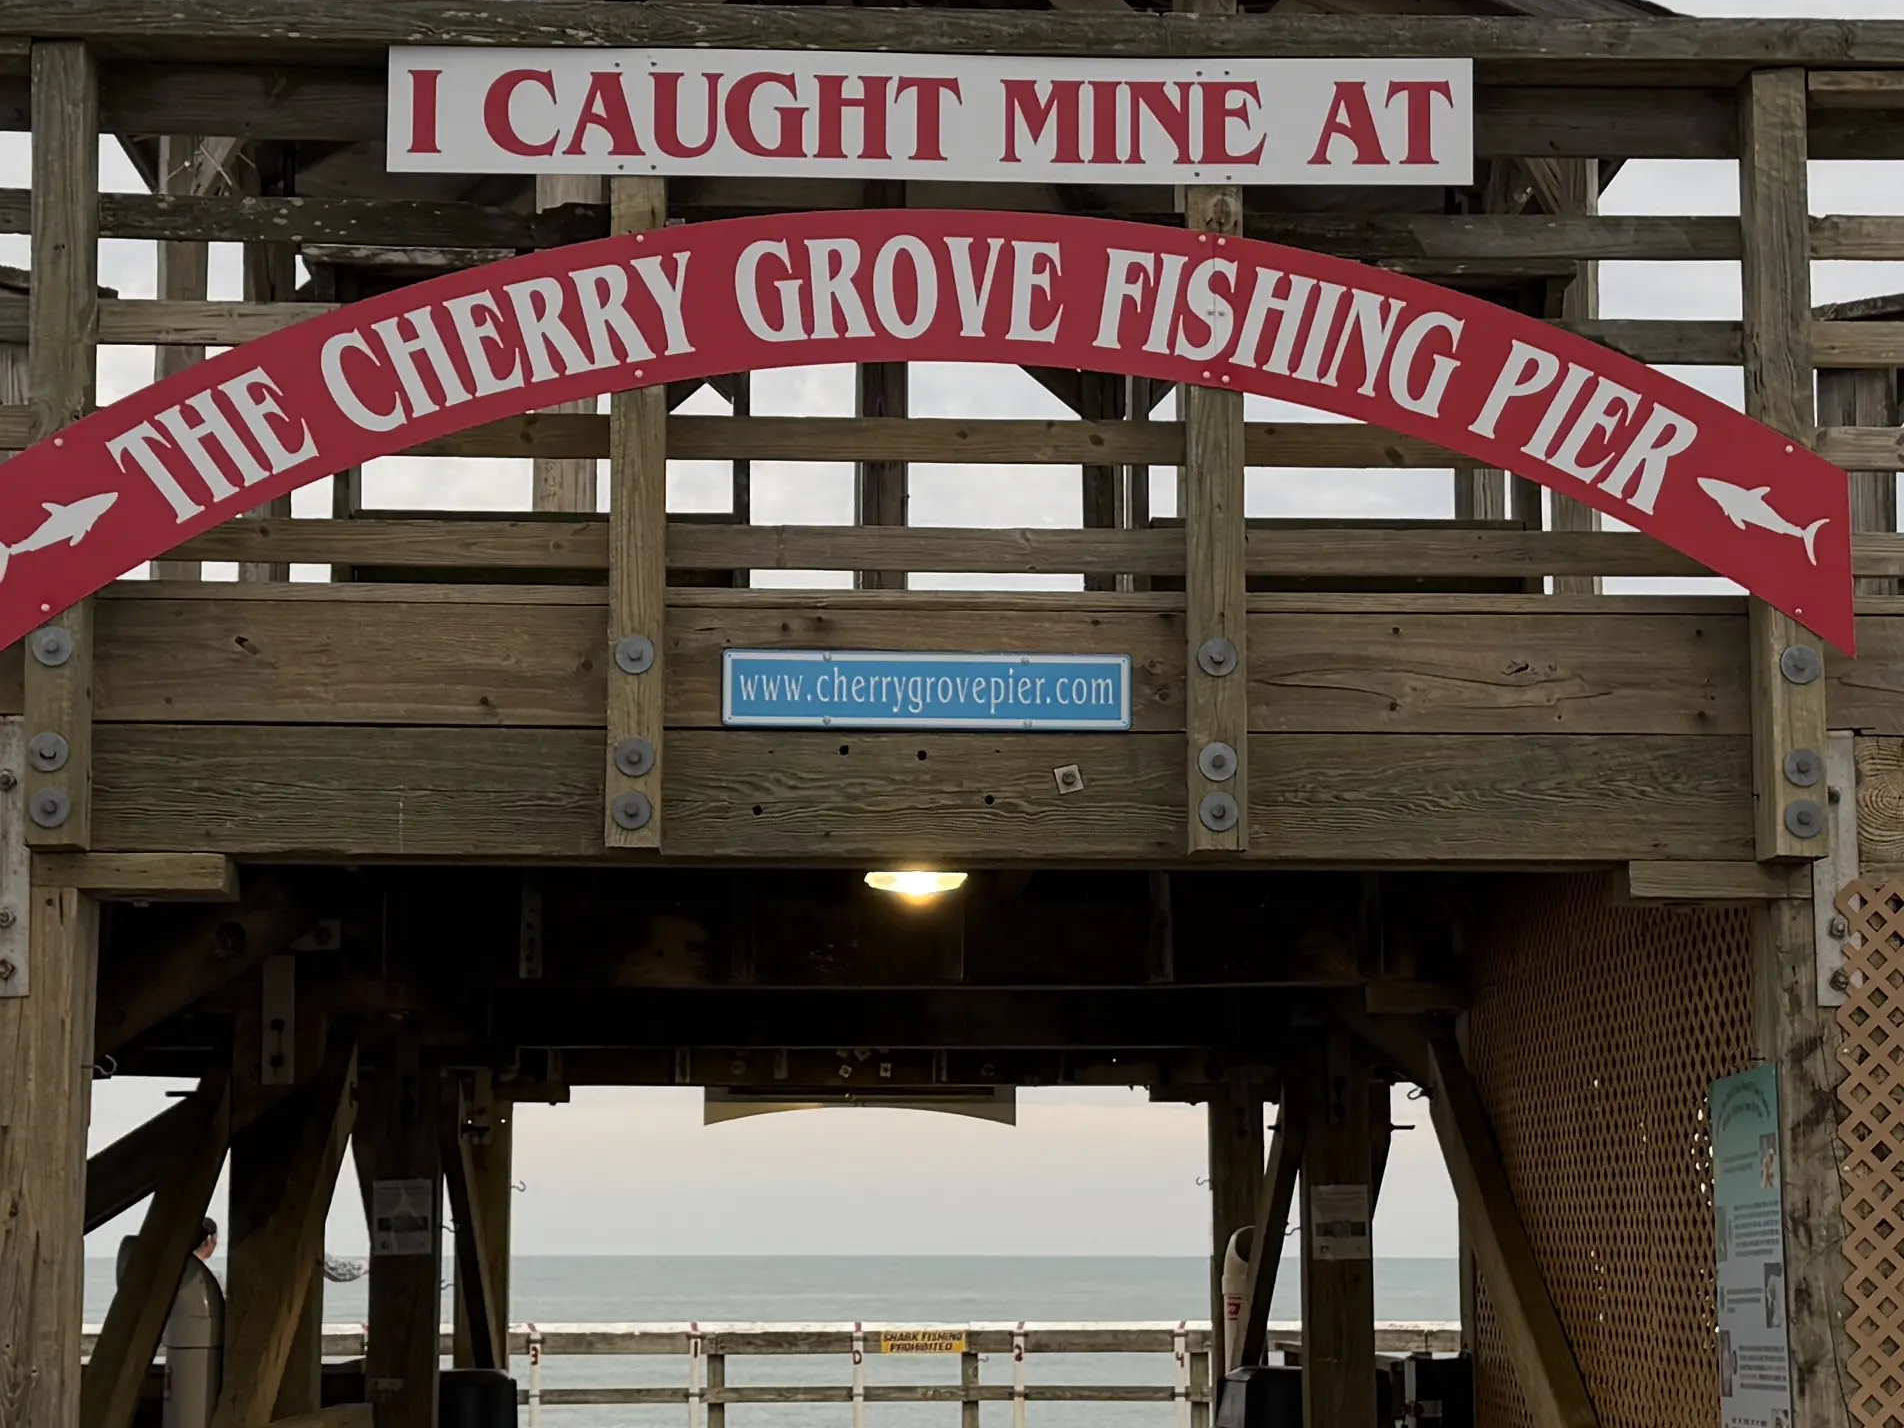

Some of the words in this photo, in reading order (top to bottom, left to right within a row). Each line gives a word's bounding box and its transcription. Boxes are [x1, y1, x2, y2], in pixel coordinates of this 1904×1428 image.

[411, 70, 440, 154] I
[484, 70, 960, 161] CAUGHT
[1003, 80, 1264, 165] MINE
[1313, 82, 1451, 165] AT
[106, 367, 319, 524] THE
[321, 251, 695, 433] CHERRY
[735, 234, 1062, 343] GROVE
[1092, 248, 1465, 418] FISHING
[1468, 340, 1700, 516] PIER
[738, 667, 1114, 714] www.cherrygrovepier.com
[883, 1331, 917, 1343] SHARK
[889, 1341, 952, 1352] PROHIBITED
[530, 1346, 538, 1366] 3
[1174, 1351, 1184, 1368] 4
